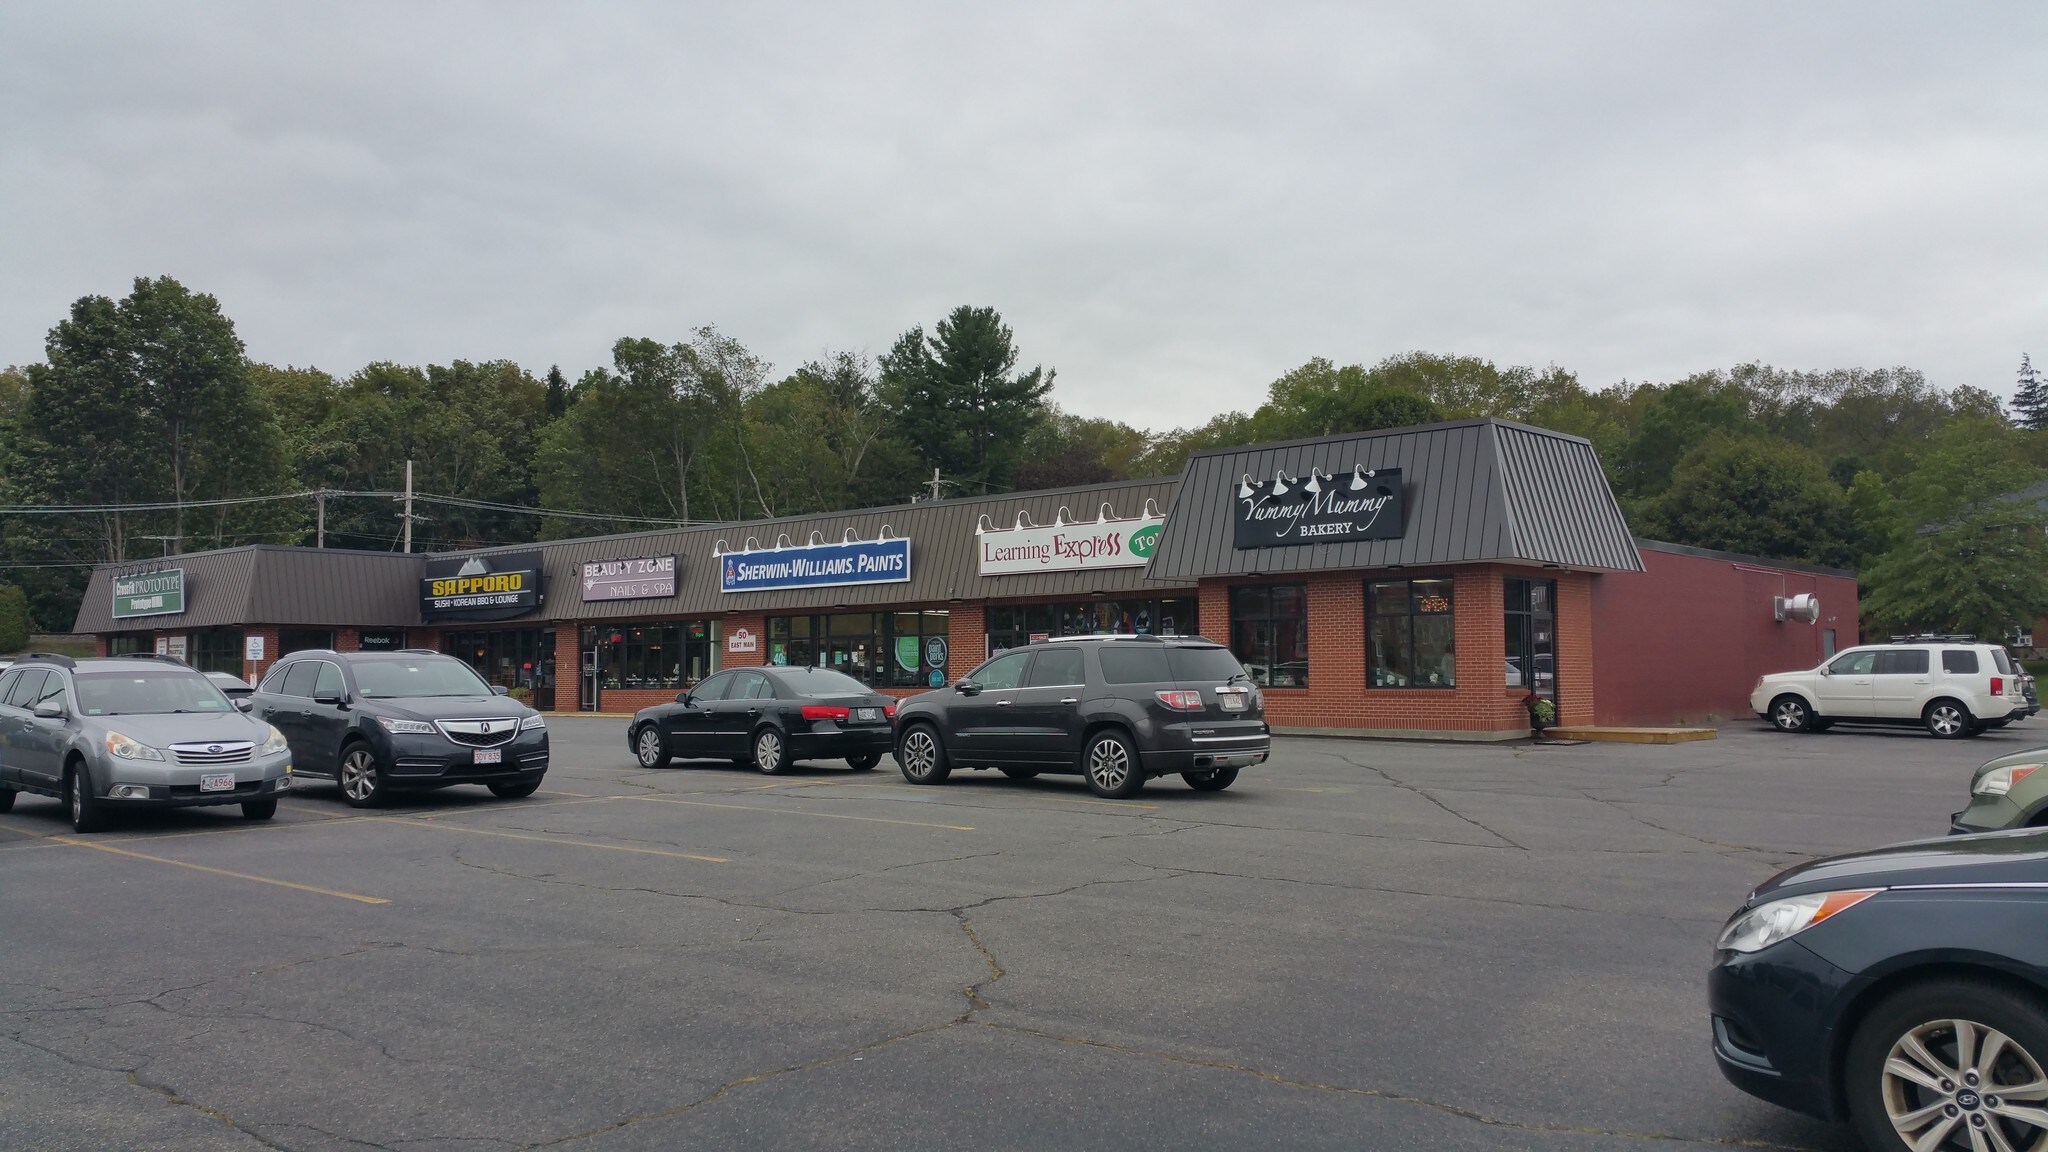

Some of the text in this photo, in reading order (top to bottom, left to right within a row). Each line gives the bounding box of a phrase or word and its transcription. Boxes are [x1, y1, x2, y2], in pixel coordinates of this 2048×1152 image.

[1242, 495, 1305, 537] Yummy
[1302, 489, 1387, 531] Mummy
[1300, 522, 1353, 537] BAKERY
[984, 540, 1051, 564] Learning
[1134, 532, 1160, 552] To
[584, 558, 673, 577] BEAUTY ZONE
[858, 554, 904, 573] PAINTS
[135, 575, 180, 594] PROTOTYPE
[432, 574, 522, 597] SAPPORO
[610, 582, 673, 597] NAILS & SPA
[434, 600, 451, 608] SUSHI
[453, 598, 476, 607] KOREAN
[476, 597, 489, 606] BBQ
[495, 595, 519, 604] LOUNGE
[364, 636, 391, 644] Reebok
[738, 631, 747, 640] 50
